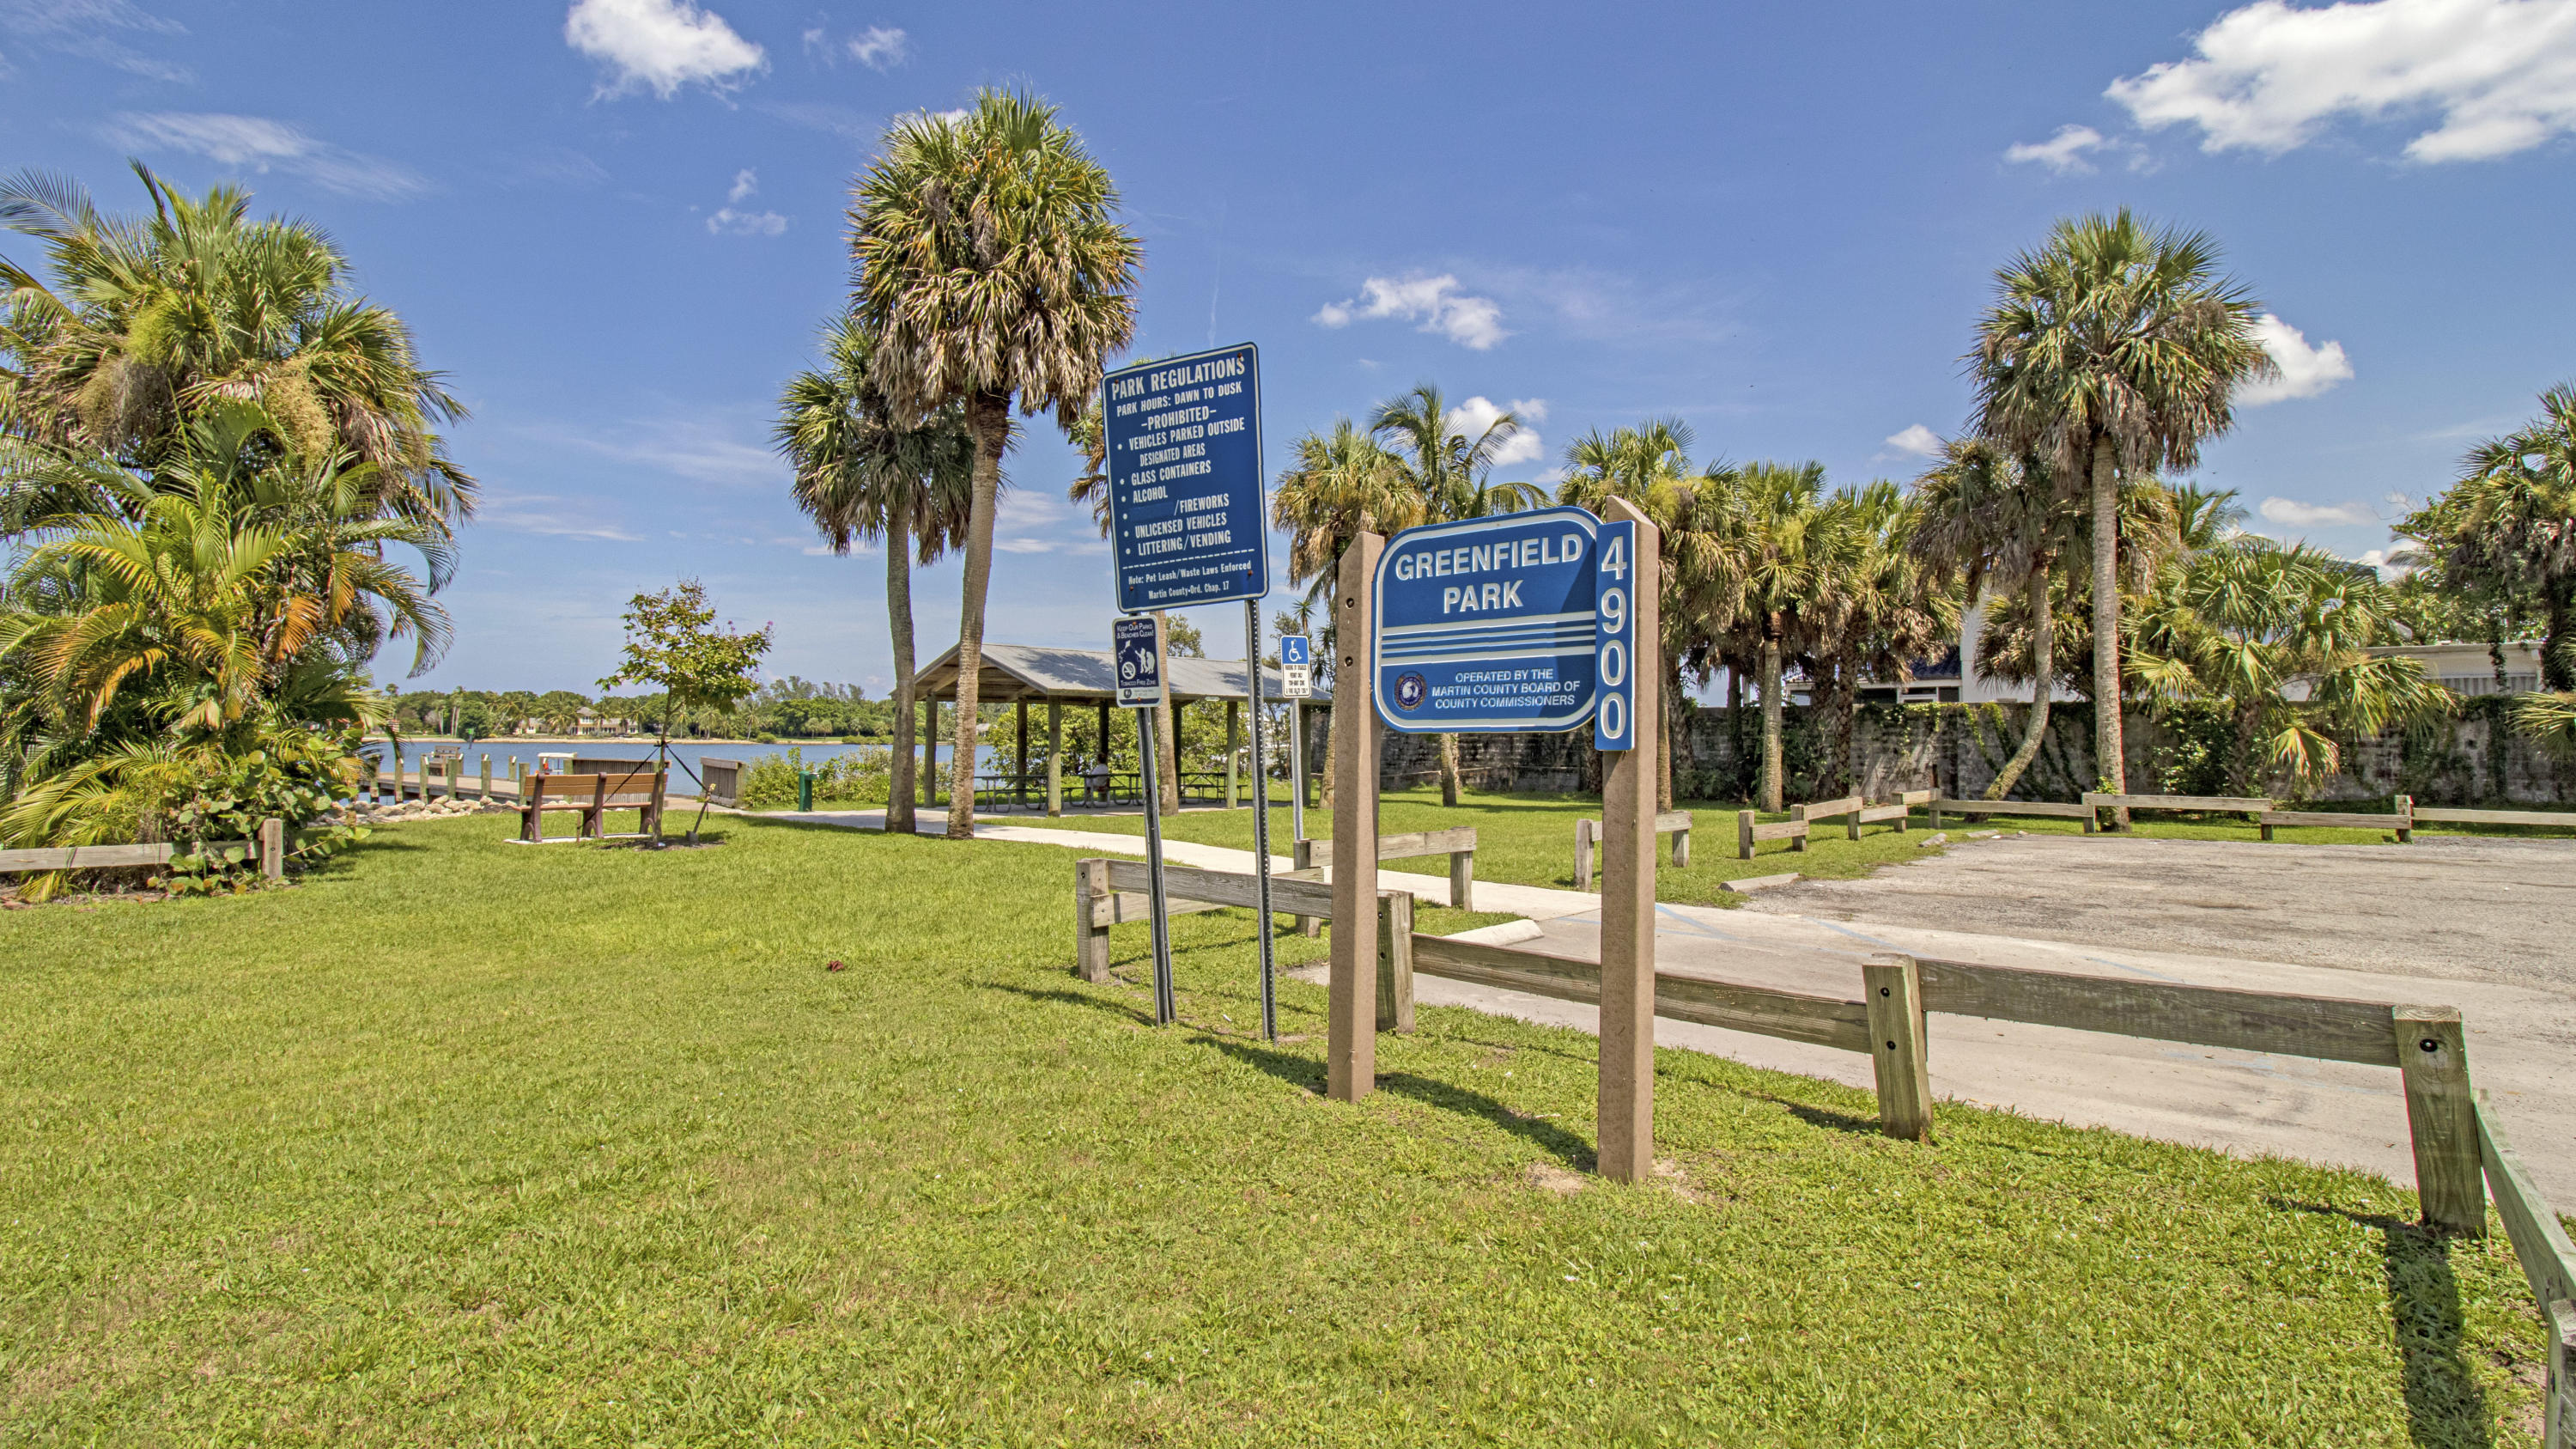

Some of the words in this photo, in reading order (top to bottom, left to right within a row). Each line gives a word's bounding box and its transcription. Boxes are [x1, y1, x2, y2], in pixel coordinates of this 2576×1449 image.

[1112, 376, 1145, 400] PARK
[1151, 356, 1245, 392] REGULATIONS
[1116, 402, 1138, 417] PARK
[1140, 396, 1171, 412] HOURS:
[1174, 389, 1200, 405] DAWN
[1202, 387, 1214, 399] TO
[1218, 381, 1242, 397] DUSK
[1128, 433, 1167, 451] VEHICLES
[1170, 425, 1204, 442] PARKED
[1207, 417, 1245, 436] OUTSIDE
[1139, 447, 1180, 466] DESIGNATED
[1182, 442, 1206, 460] AREAS
[1131, 470, 1157, 486] GLASS
[1160, 460, 1212, 481] CONTAINERS
[1133, 485, 1168, 503] ALCOHOL
[1134, 519, 1183, 539] UNLICENSED
[1186, 512, 1227, 531] VEHICLES
[1138, 530, 1231, 557] LITTERING/VENDING
[1395, 533, 1583, 581] GREENFIELD
[1128, 575, 1144, 585] Note:
[1145, 573, 1157, 582] Pet
[1158, 567, 1200, 581] Leash/Waste
[1202, 565, 1218, 575] Laws
[1220, 560, 1251, 573] Enforced
[1148, 589, 1167, 600] Martin
[1204, 582, 1221, 593] Chap.
[1223, 581, 1230, 590] 17
[1443, 580, 1524, 613] PARK
[1601, 535, 1627, 740] 4900
[1431, 685, 1471, 697] MARTIN
[1473, 683, 1519, 695] COUNTY
[1522, 682, 1561, 693] BOARD
[1564, 680, 1581, 691] OF
[1455, 670, 1512, 683] OPERATED
[1514, 669, 1529, 680] BY
[1531, 668, 1553, 679] THE
[1435, 697, 1478, 709] COUNTY
[1480, 695, 1576, 708] COMMISSIONERS
